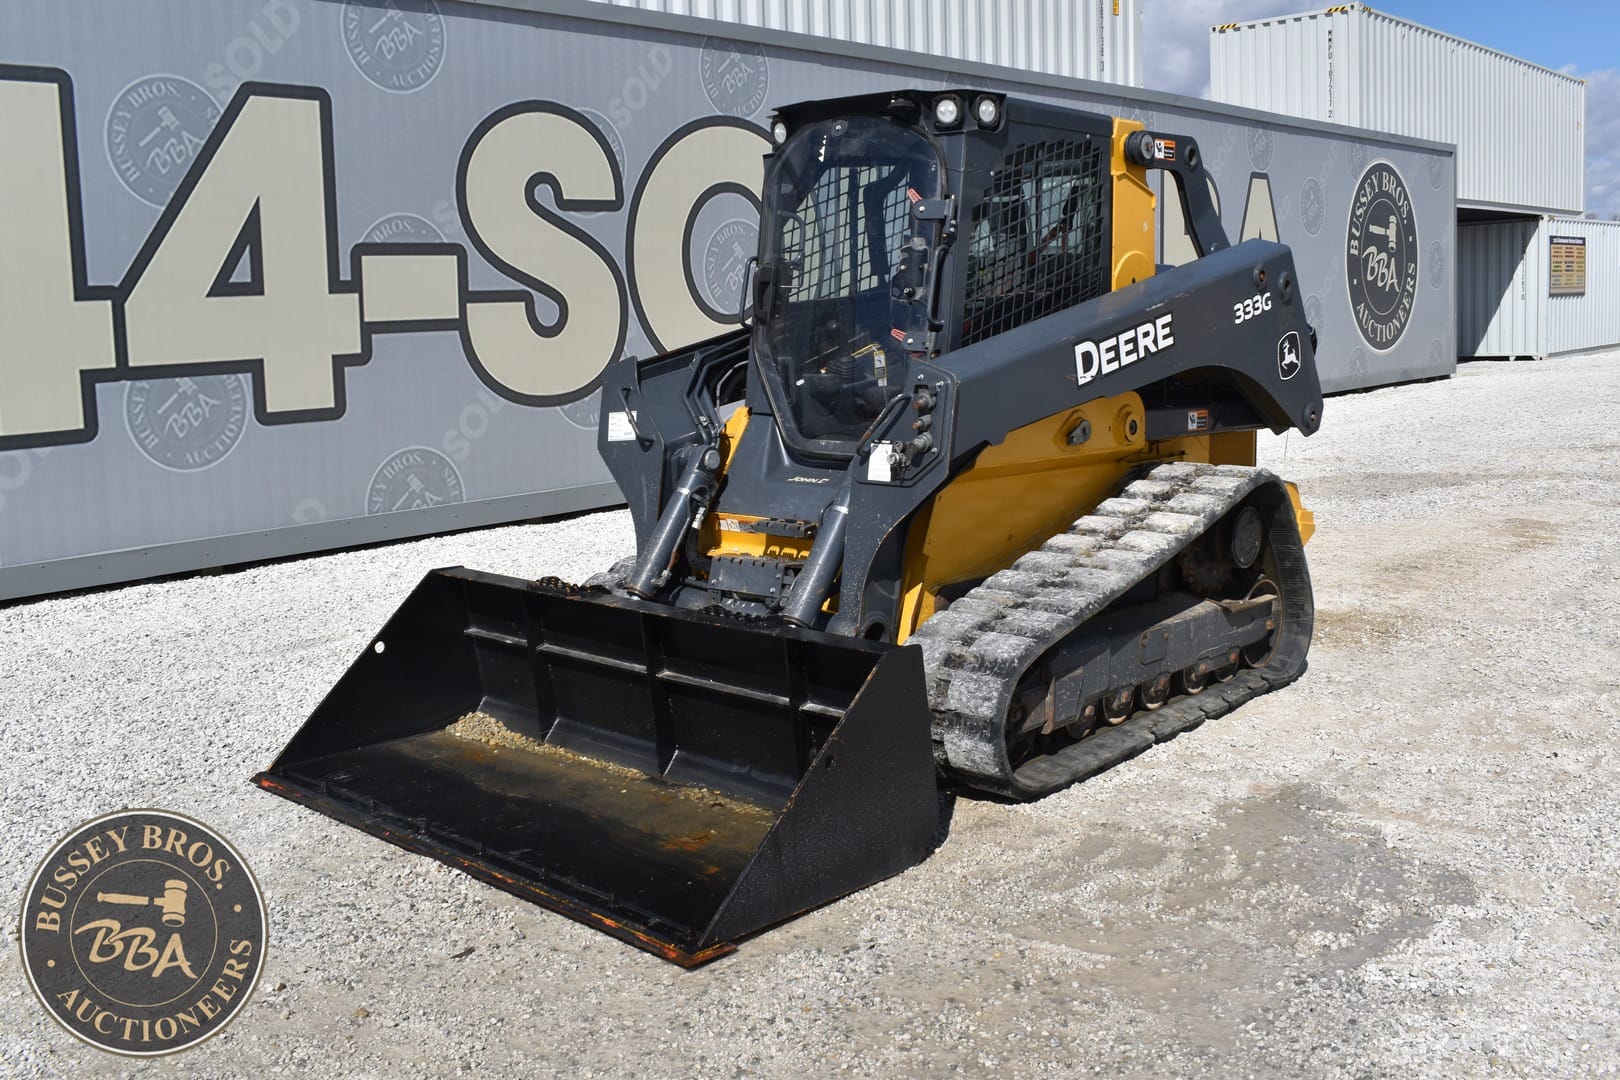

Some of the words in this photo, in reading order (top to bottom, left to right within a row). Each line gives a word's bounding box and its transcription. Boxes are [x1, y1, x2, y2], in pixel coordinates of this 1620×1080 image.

[1350, 172, 1380, 256] BUSSEY
[1382, 171, 1410, 225] BROS.
[1356, 262, 1416, 342] AUCTIONEERS
[1362, 245, 1400, 292] BBA
[1233, 292, 1272, 326] 333G
[1074, 313, 1175, 386] DEERE
